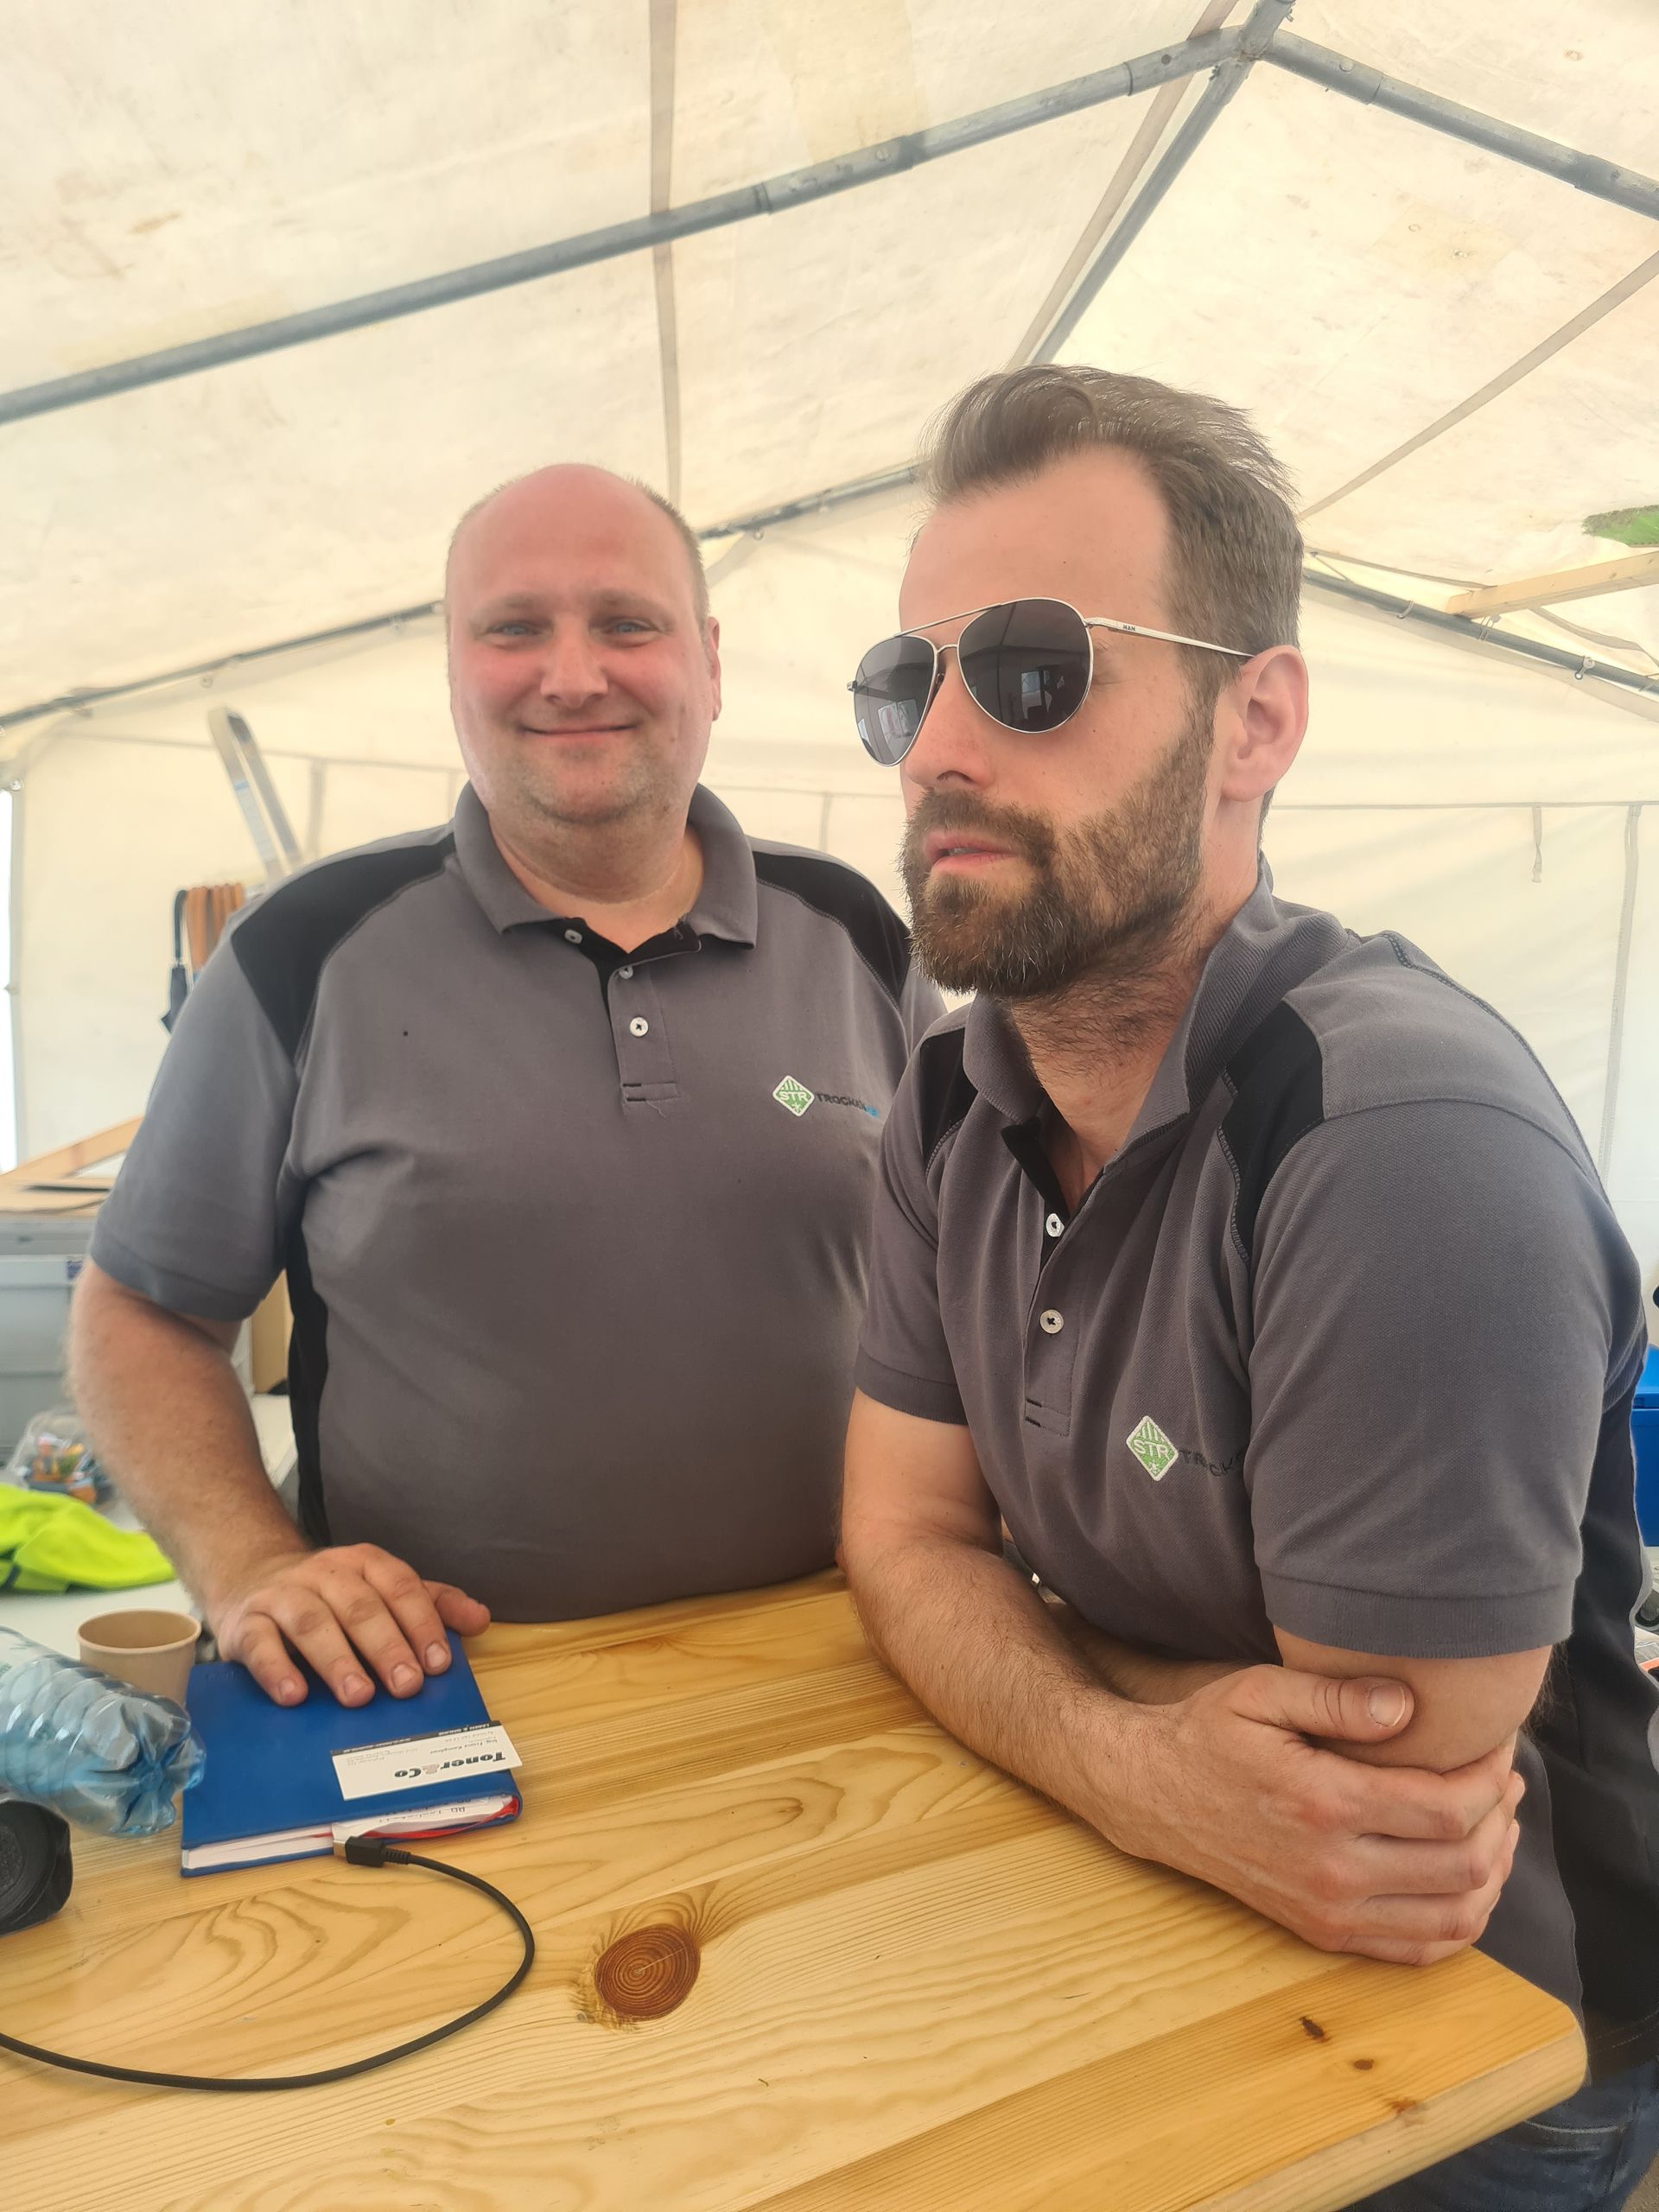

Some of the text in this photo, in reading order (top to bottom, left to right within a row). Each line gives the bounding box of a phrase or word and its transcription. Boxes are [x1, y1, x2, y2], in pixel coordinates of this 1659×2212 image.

[779, 1090, 809, 1102] STR
[1133, 1439, 1171, 1461] STR
[394, 1751, 506, 1778] Toner&Co
